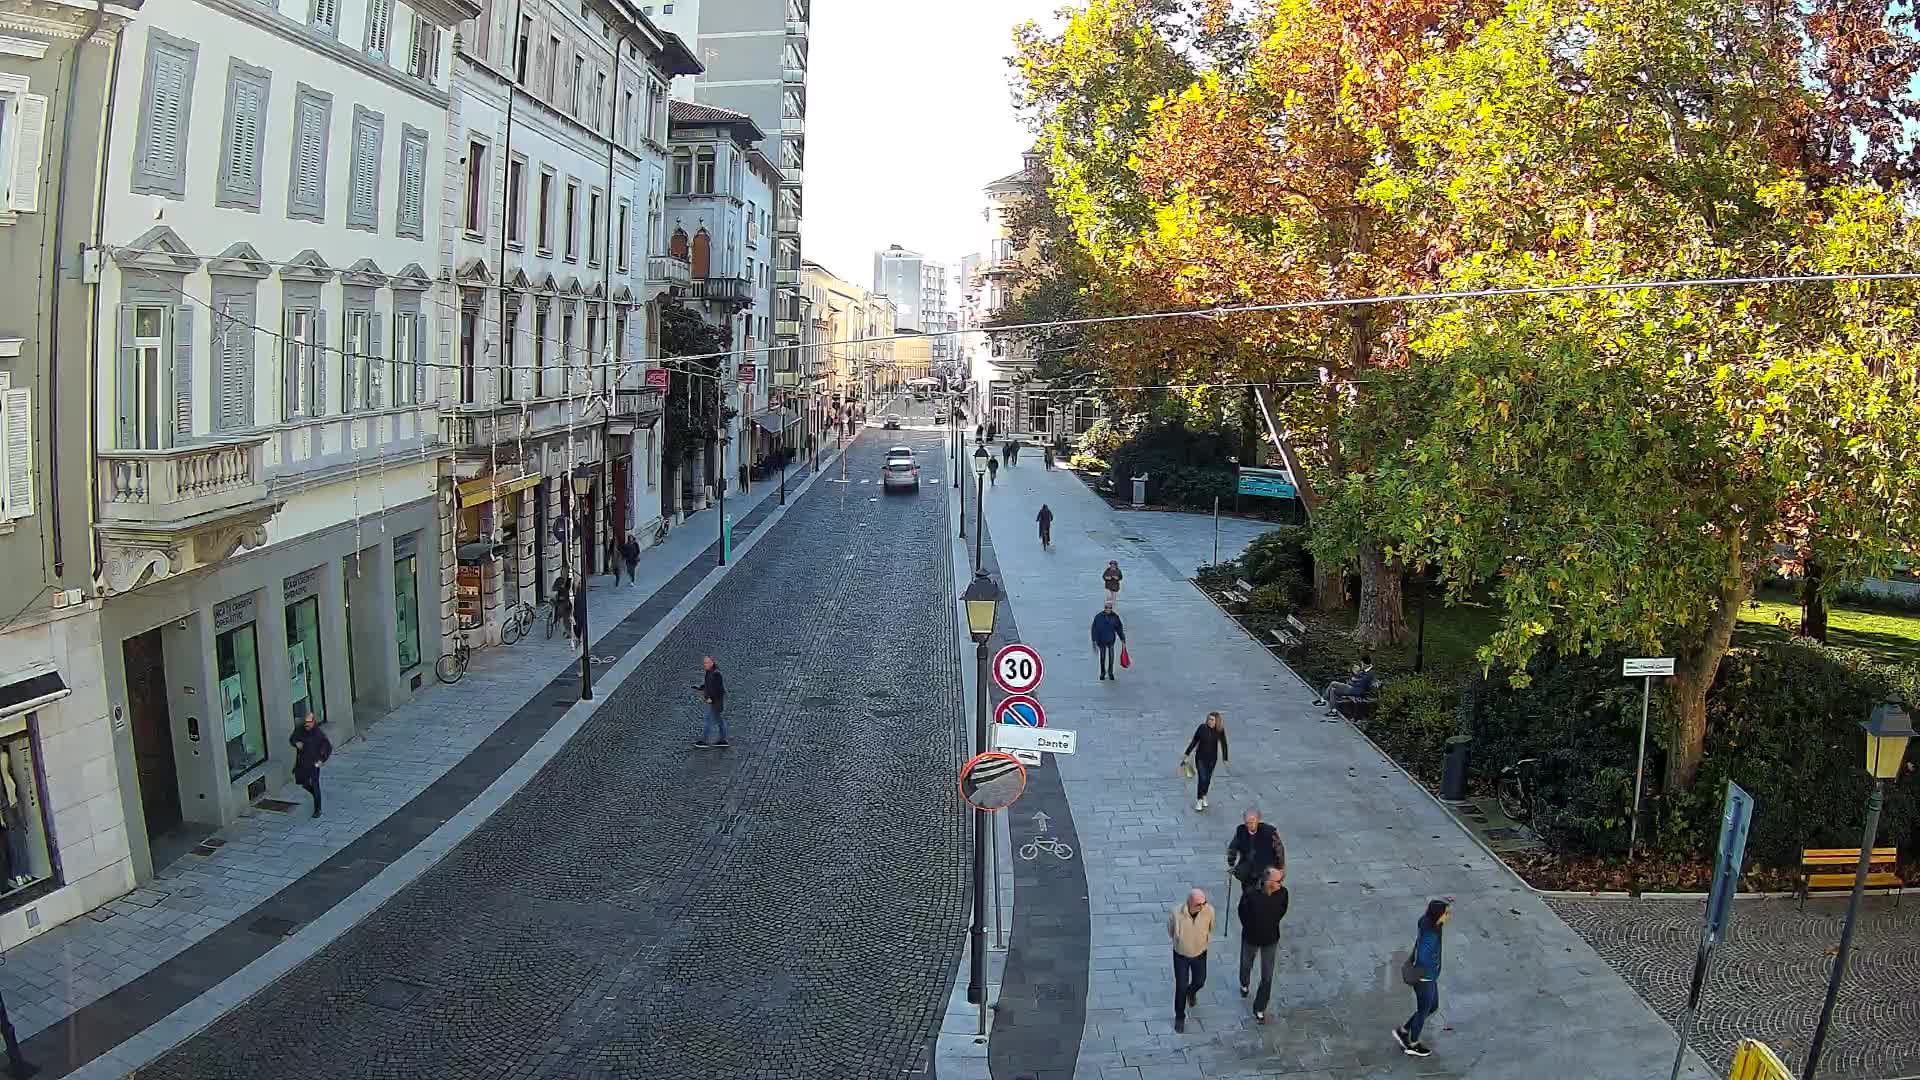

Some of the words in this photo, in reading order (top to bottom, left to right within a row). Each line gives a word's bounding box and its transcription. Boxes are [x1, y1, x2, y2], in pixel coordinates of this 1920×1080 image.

[215, 611, 244, 628] OPERATIVO
[1005, 658, 1032, 680] 30
[1037, 737, 1069, 749] Dante
